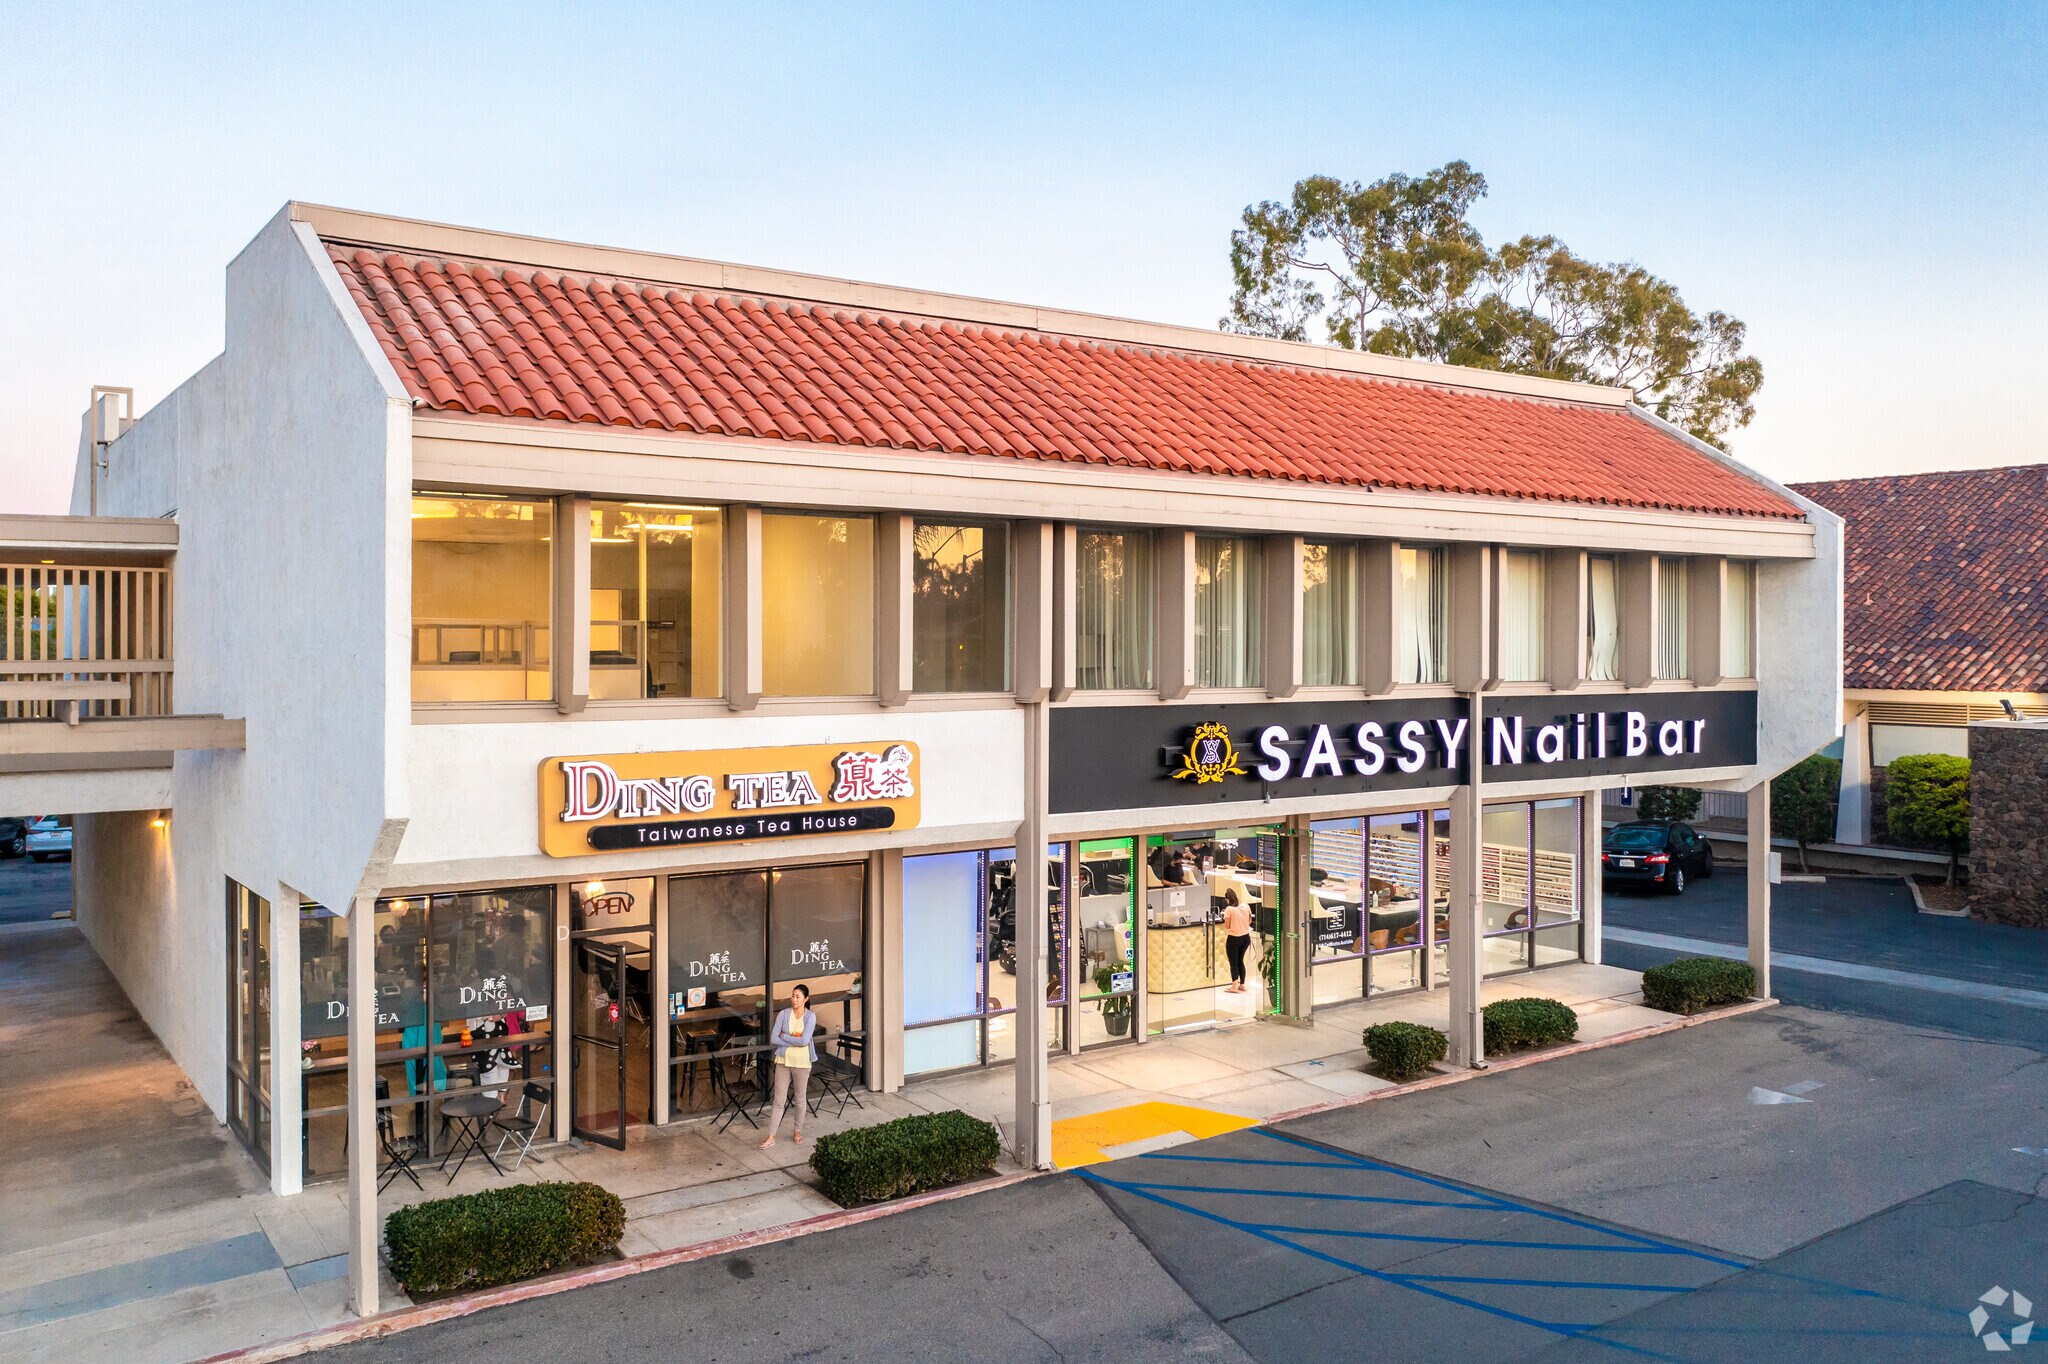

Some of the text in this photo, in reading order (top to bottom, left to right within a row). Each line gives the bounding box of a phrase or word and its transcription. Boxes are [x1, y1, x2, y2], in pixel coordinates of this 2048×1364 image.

[1257, 719, 1468, 781] SASSY
[1492, 712, 1606, 766] Nail
[1626, 711, 1705, 757] Bar
[562, 761, 822, 822] DING TEA
[638, 815, 857, 842] Taiwanese Tea House
[582, 897, 631, 916] OPEN
[557, 925, 570, 941] D
[790, 949, 829, 965] DING
[820, 960, 845, 970] TEA
[689, 961, 731, 977] DING
[720, 972, 747, 983] TEA
[459, 987, 508, 1005] DING
[496, 998, 526, 1010] TEA
[375, 1012, 400, 1025] EA
